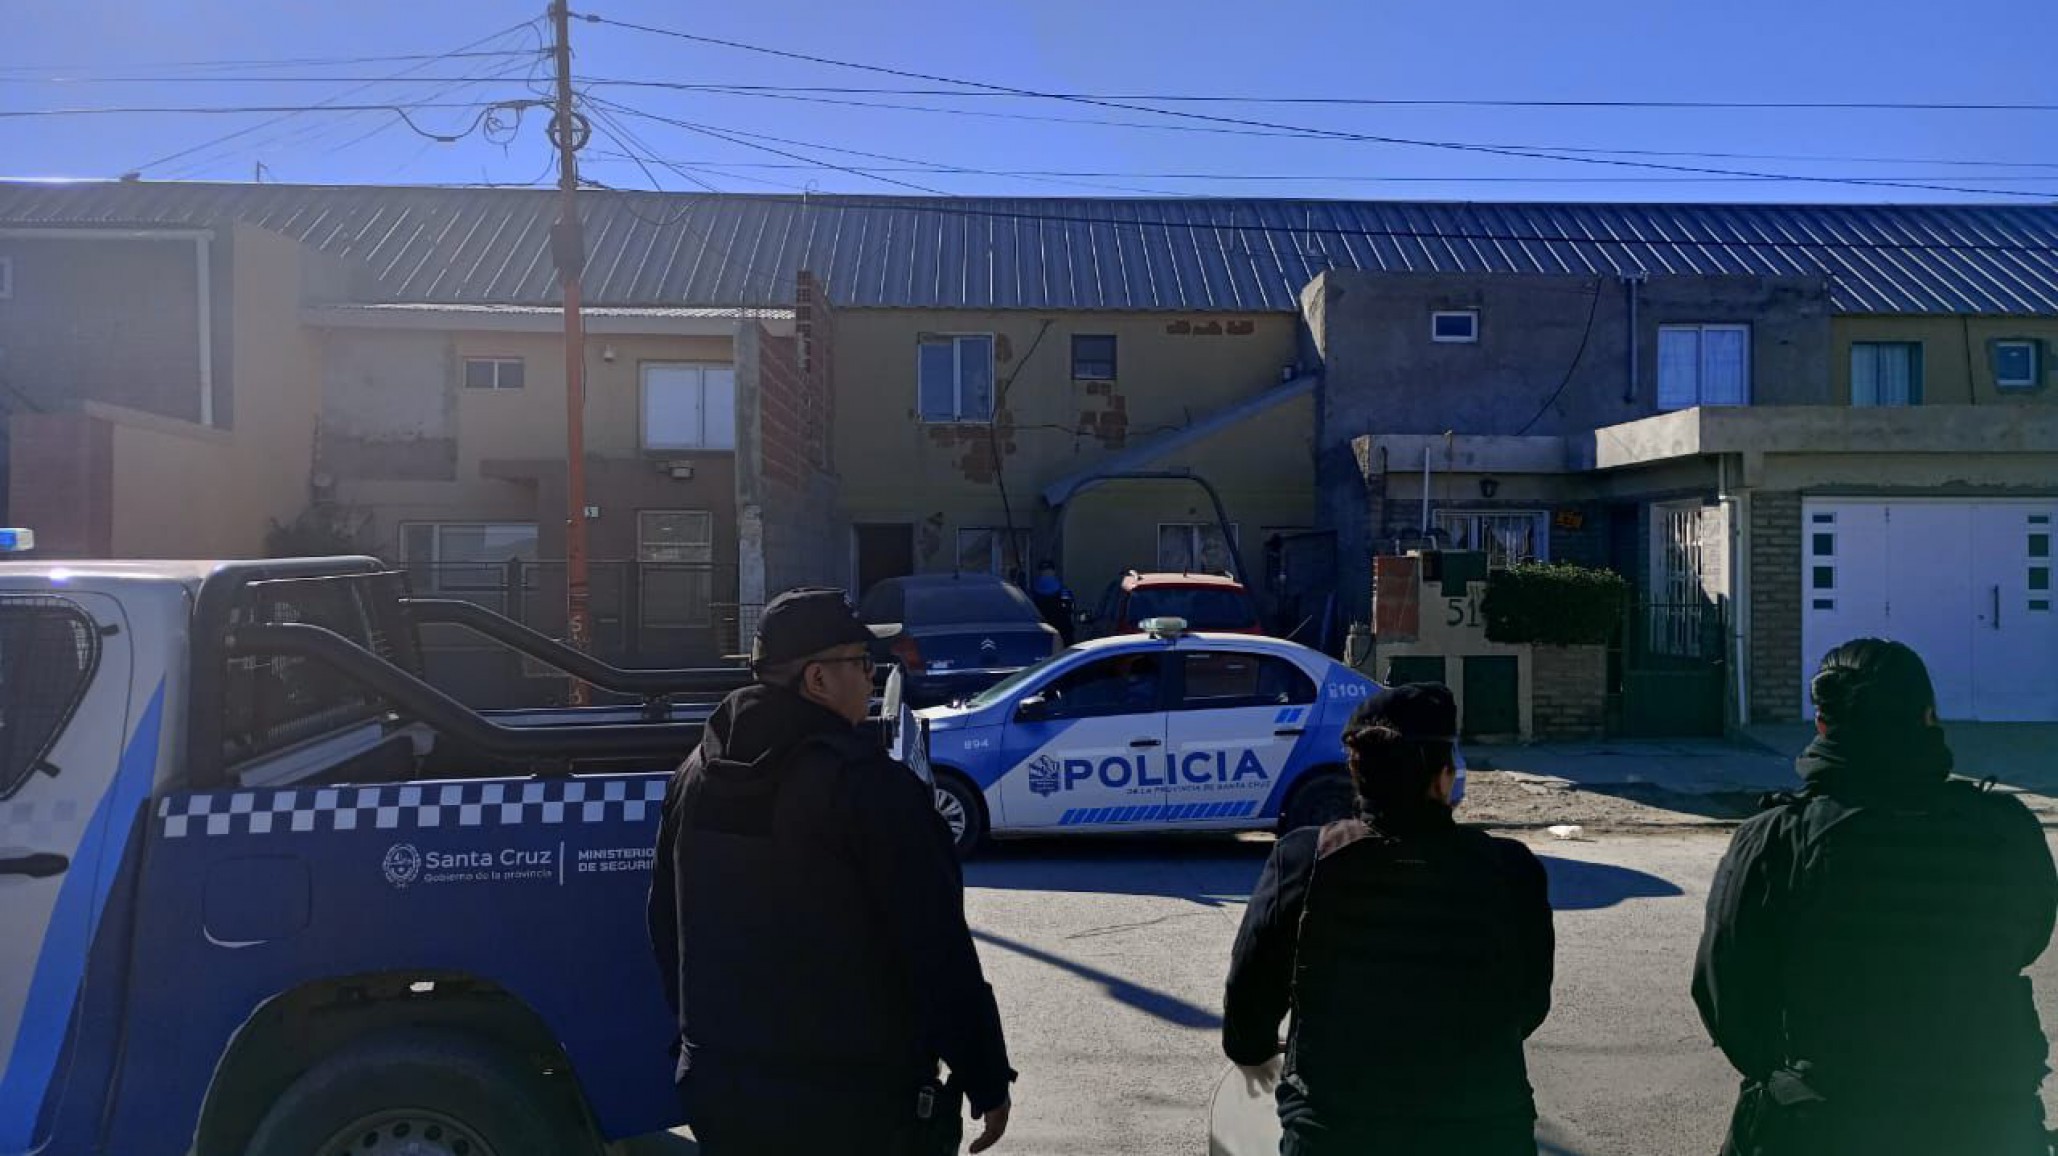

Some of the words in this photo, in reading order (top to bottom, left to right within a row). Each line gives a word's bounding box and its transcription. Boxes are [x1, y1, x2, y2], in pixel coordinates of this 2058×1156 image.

[1339, 683, 1367, 697] 101
[1064, 749, 1269, 790] POLICIA
[1217, 782, 1246, 791] SANTA
[425, 850, 493, 868] Santa
[500, 848, 552, 865] Cruz
[578, 848, 655, 860] MINISTERIO
[578, 862, 597, 872] DE
[599, 860, 654, 871] SEGURI
[424, 873, 474, 883] Gobierno
[475, 871, 488, 880] de
[491, 870, 501, 879] la
[504, 869, 552, 881] provincia
